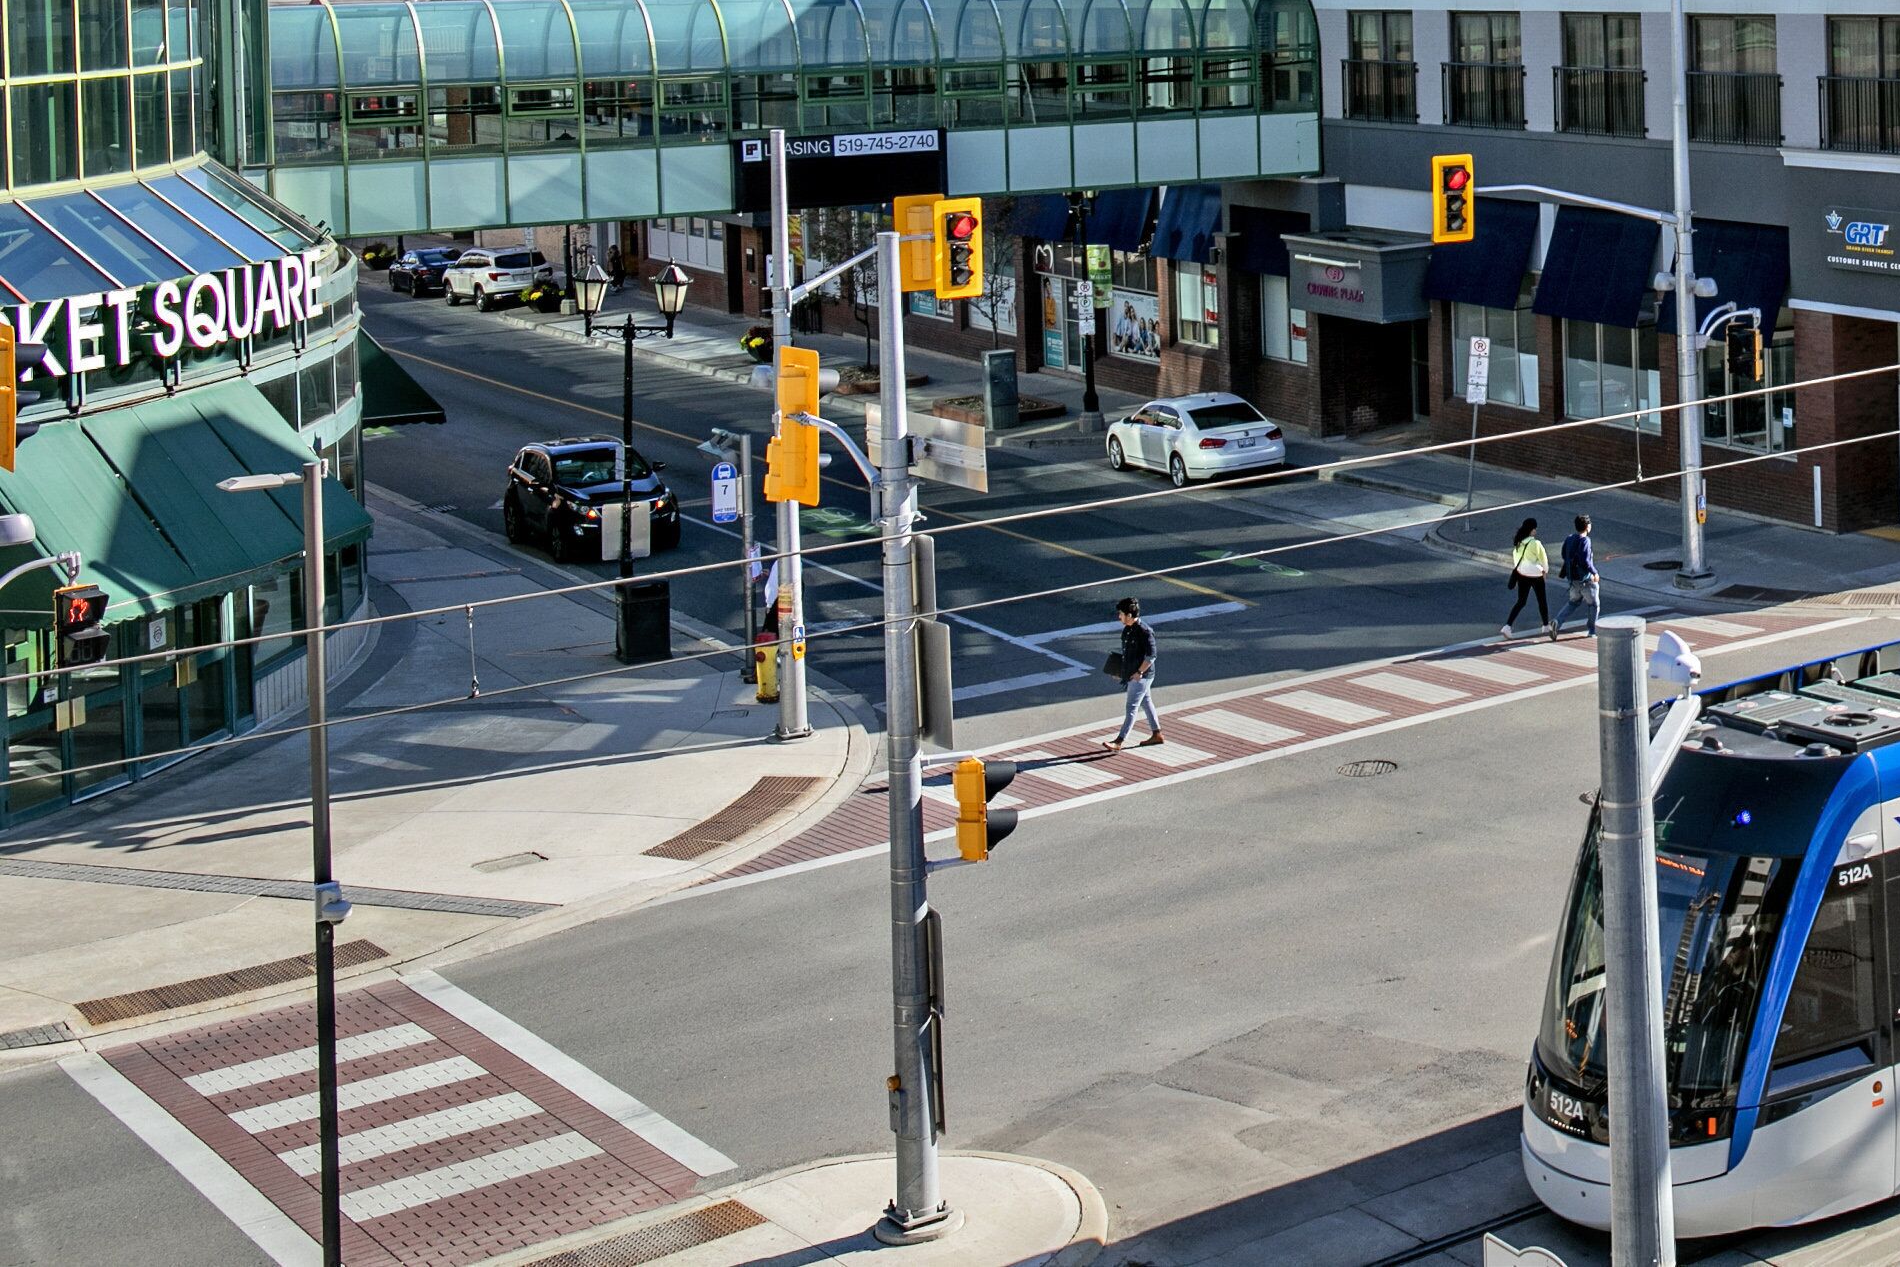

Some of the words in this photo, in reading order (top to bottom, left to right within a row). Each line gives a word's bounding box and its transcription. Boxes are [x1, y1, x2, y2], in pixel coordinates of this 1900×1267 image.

[764, 140, 831, 156] LASING
[838, 134, 935, 153] 519-745-2740
[1845, 222, 1889, 246] GRT
[1827, 255, 1860, 265] CUSTOMER
[1862, 259, 1888, 269] SERVICE
[0, 290, 137, 383] KET
[152, 248, 324, 358] SQUARE
[721, 484, 729, 495] 7
[1838, 864, 1873, 886] 512A
[1550, 1091, 1584, 1121] 512A
